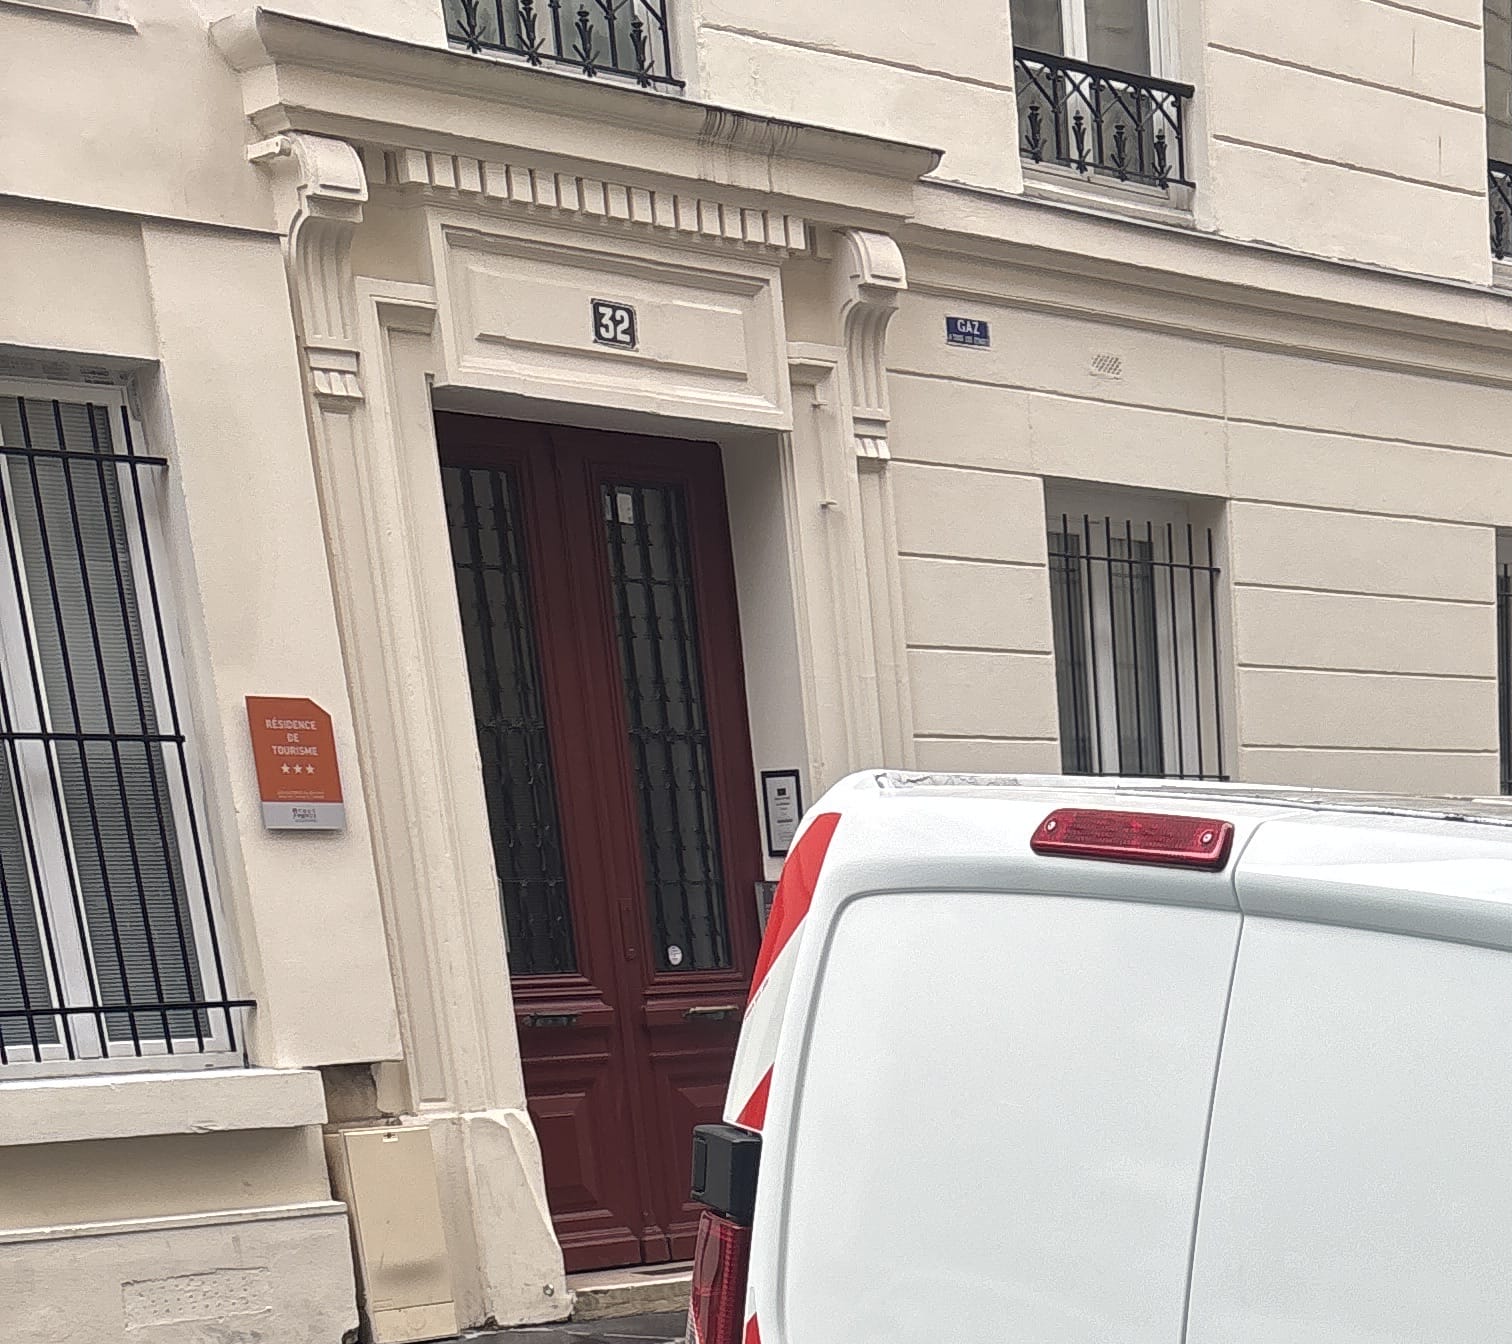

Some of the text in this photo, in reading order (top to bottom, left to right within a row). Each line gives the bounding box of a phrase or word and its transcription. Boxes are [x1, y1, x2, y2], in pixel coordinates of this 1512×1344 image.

[599, 306, 631, 342] 32
[957, 320, 980, 335] GAZ
[265, 716, 317, 730] RÉSIDENCE
[287, 732, 300, 743] DE
[271, 745, 319, 756] TOURISME
